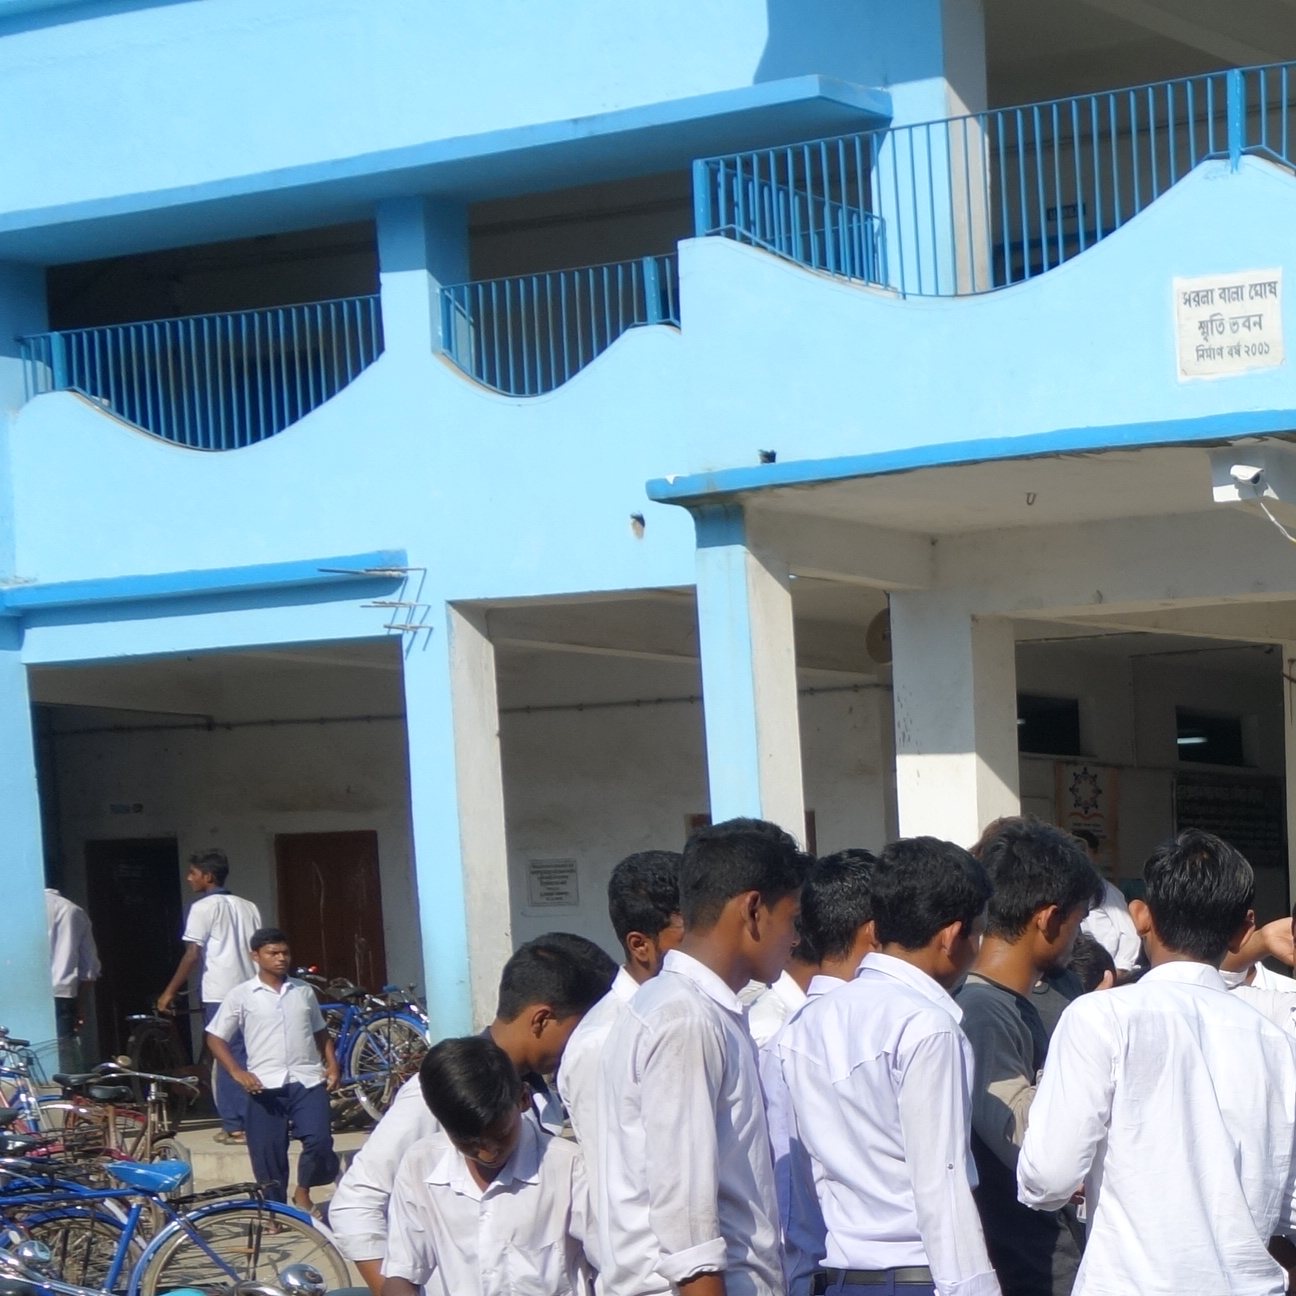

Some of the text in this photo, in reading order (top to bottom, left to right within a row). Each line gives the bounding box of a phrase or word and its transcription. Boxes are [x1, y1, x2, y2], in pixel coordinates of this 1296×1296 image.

[1182, 280, 1279, 308] সরলা বালা ঘোষ
[1197, 312, 1264, 342] স্মৃতি ভবন
[1195, 341, 1271, 361] নির্মাণ বর্ষ ২০০১
